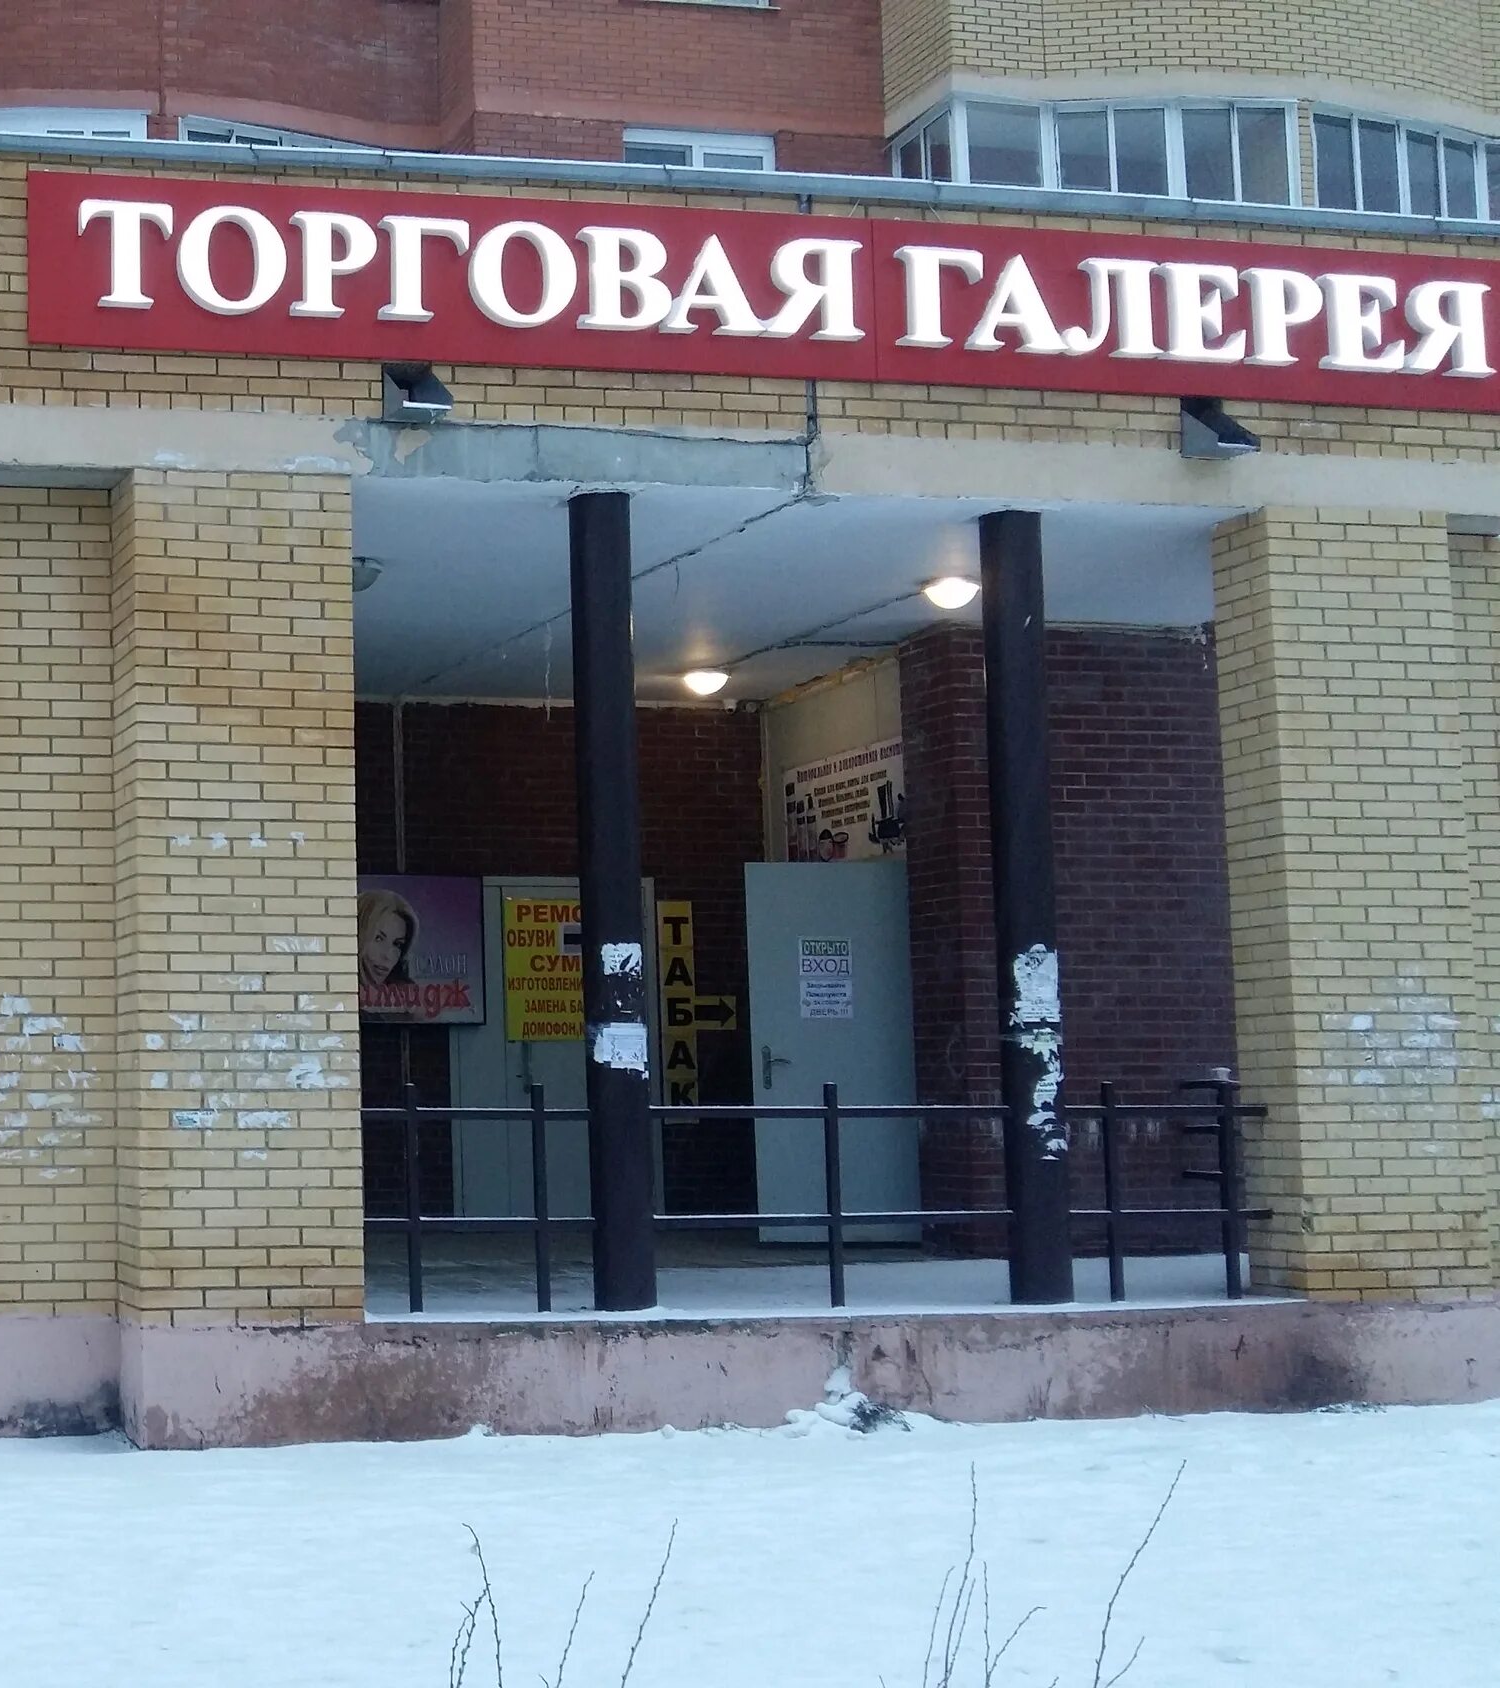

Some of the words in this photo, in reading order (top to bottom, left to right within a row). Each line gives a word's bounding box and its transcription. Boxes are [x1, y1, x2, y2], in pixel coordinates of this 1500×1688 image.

[77, 198, 866, 342] ТОРГОВАЯ
[893, 244, 1498, 379] ГАЛЕРЕЯ
[506, 929, 556, 948] ОБУВИ
[803, 941, 848, 955] ОТКРЫТО
[530, 954, 581, 973] СУМ
[802, 959, 850, 976] ВХОД
[524, 999, 567, 1014] ЗАМЕНА
[663, 916, 698, 1107] ТАБАК
